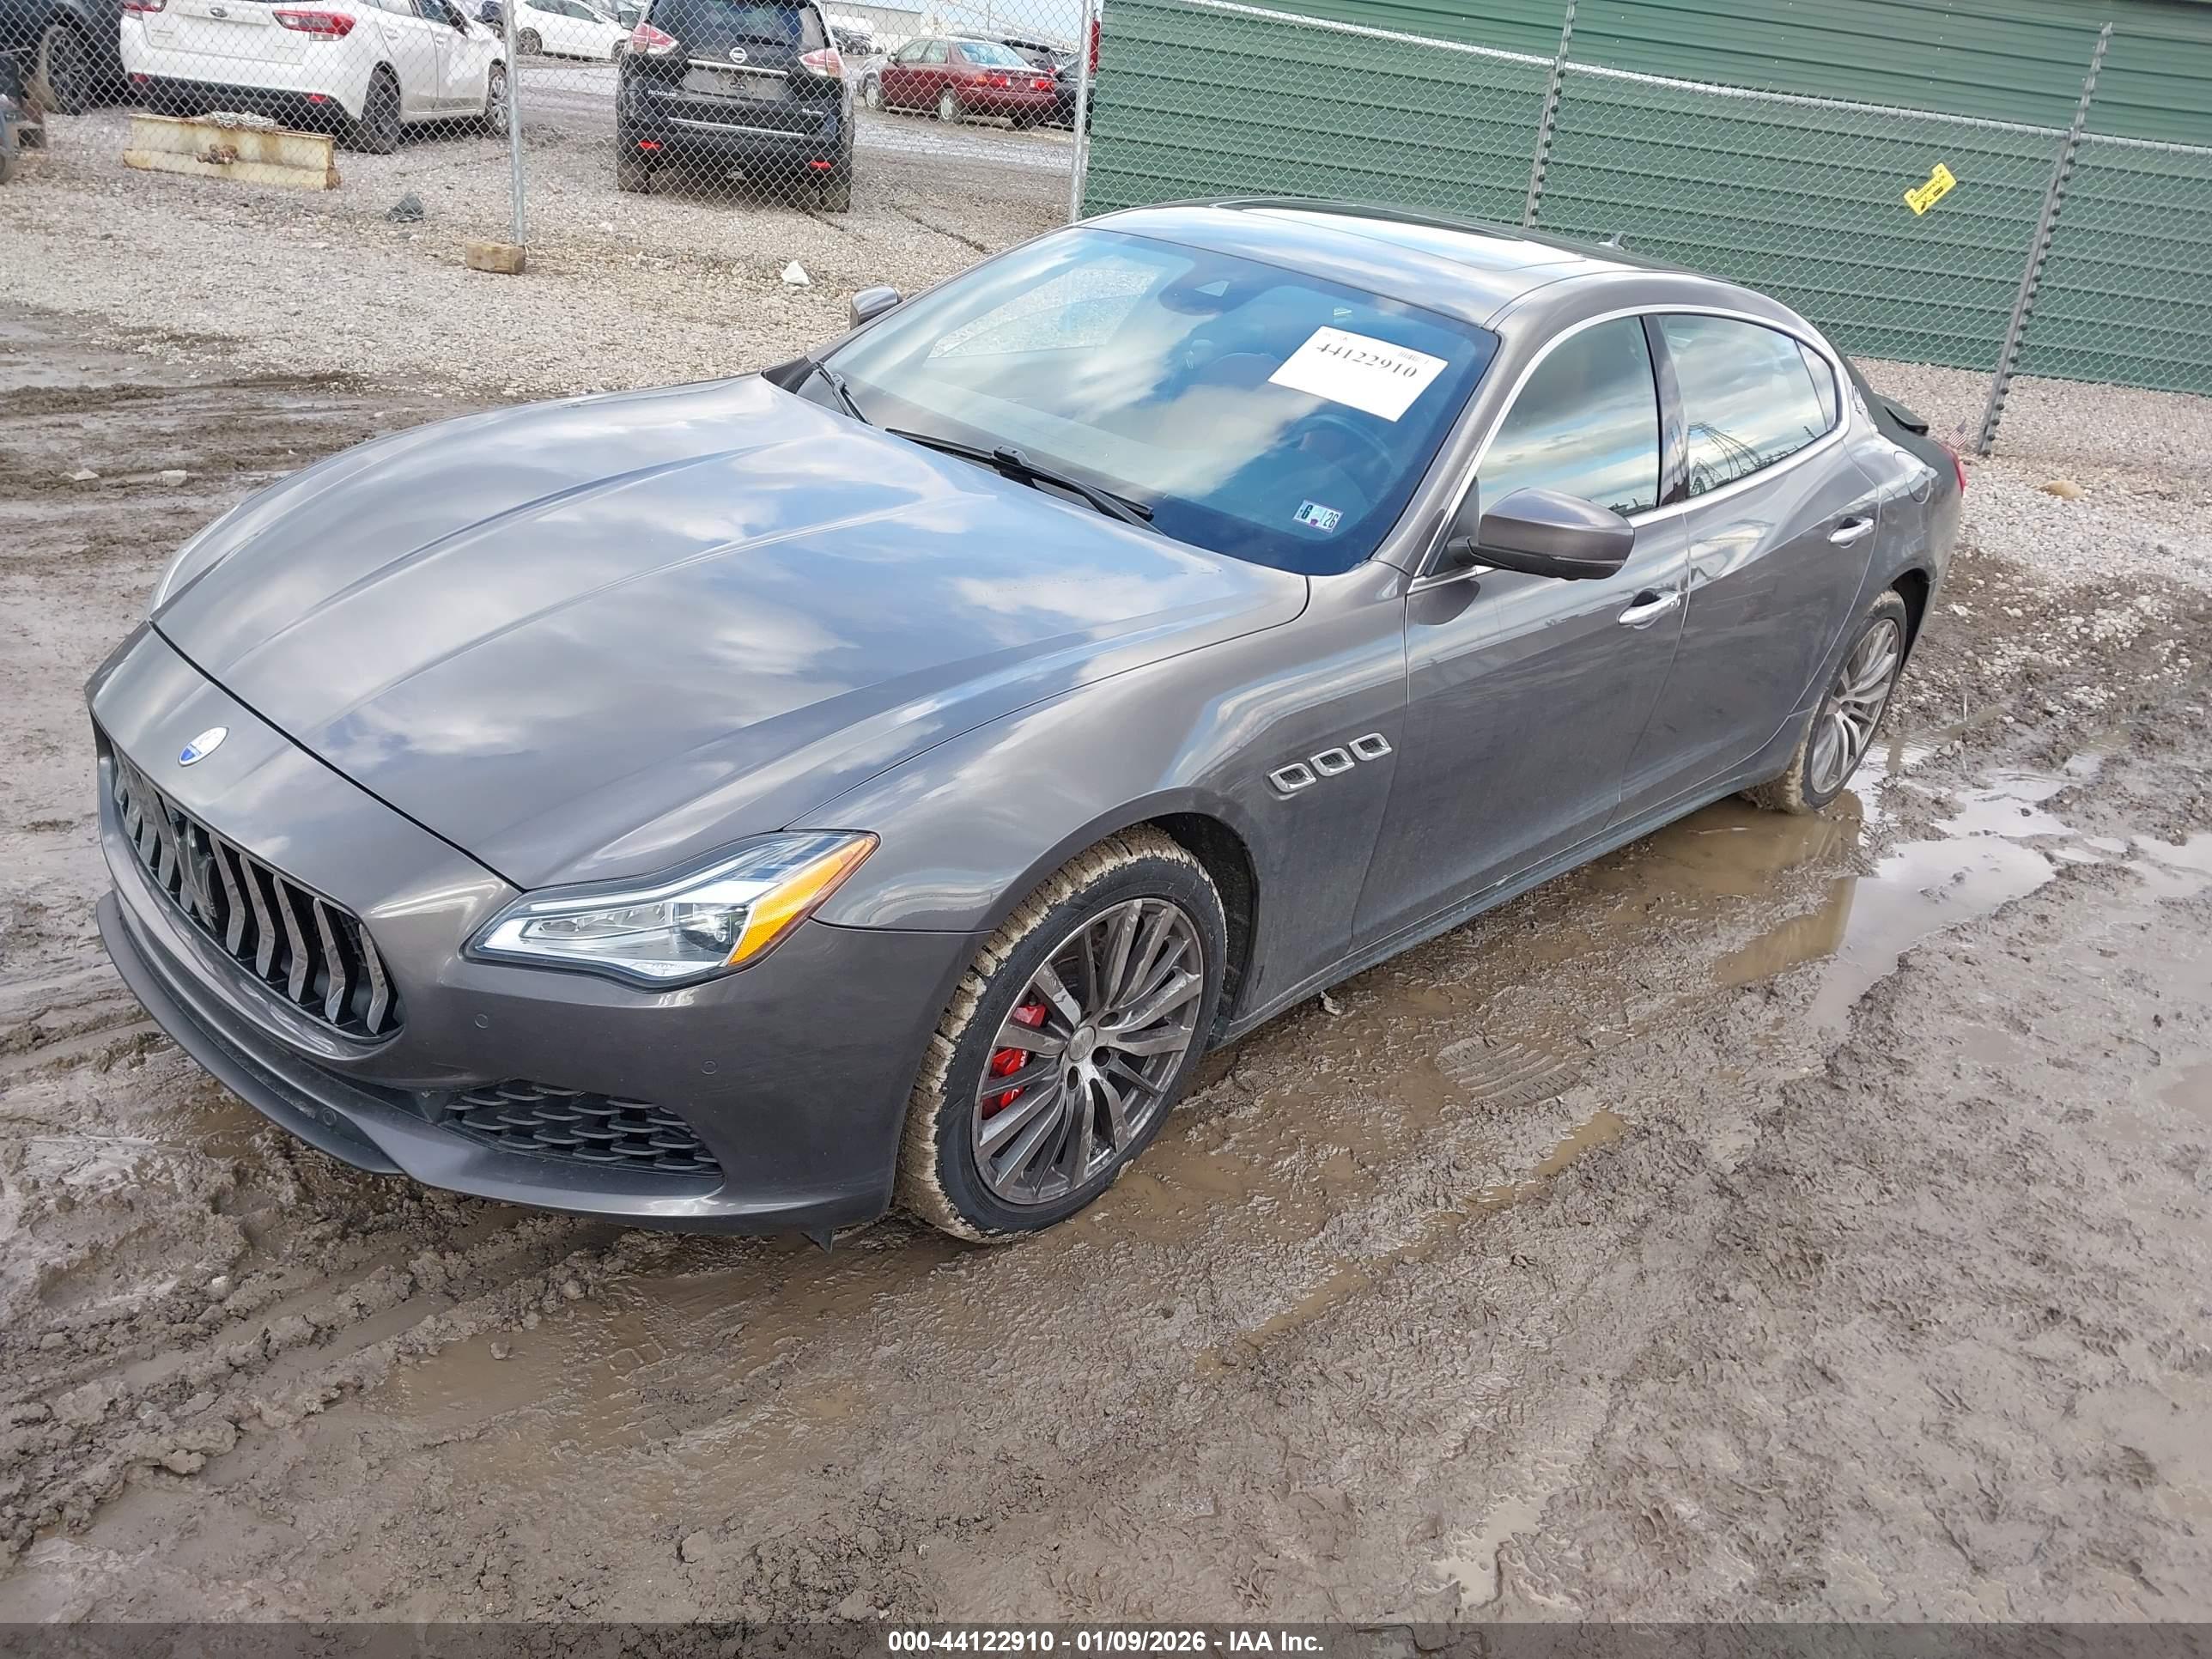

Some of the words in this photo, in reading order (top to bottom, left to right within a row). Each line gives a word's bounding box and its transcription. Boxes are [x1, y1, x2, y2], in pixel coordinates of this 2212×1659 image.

[1316, 343, 1418, 378] 44122910
[1301, 504, 1314, 520] 6
[1323, 512, 1340, 528] 26
